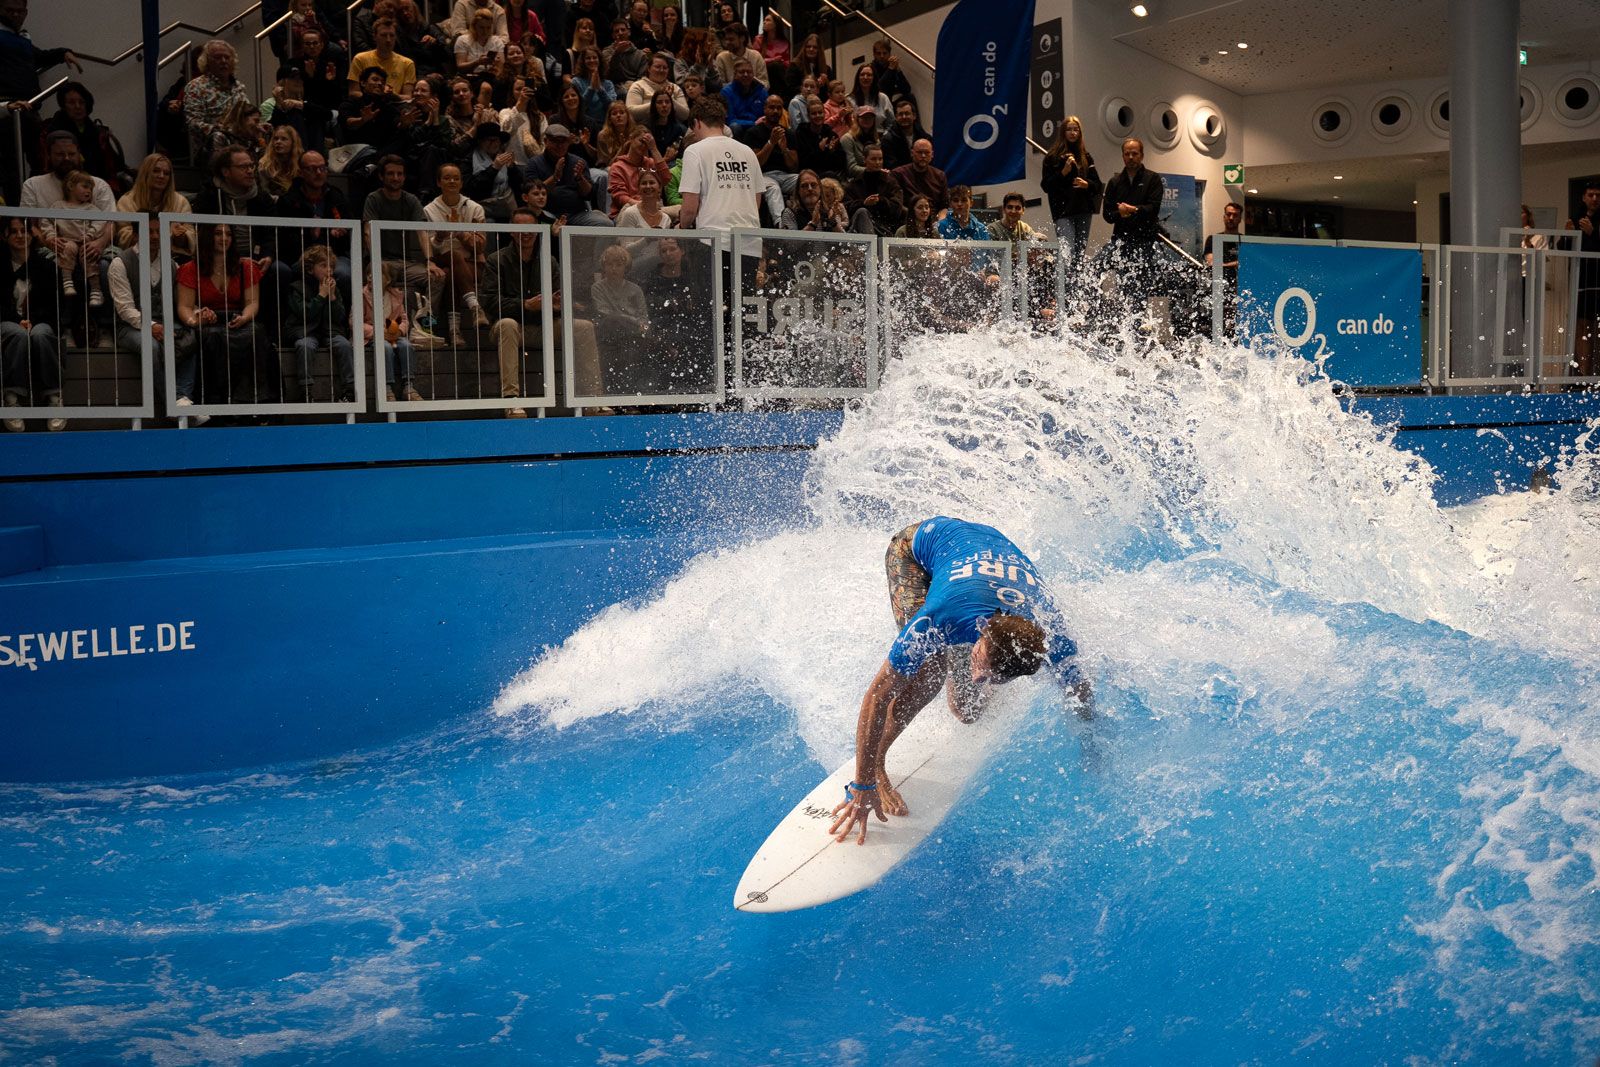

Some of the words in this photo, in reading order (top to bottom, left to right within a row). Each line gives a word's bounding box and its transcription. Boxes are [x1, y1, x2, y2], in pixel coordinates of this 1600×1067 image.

[982, 41, 997, 62] do
[984, 67, 995, 96] can
[716, 161, 748, 173] SURF
[717, 173, 751, 182] MASTERS
[1162, 188, 1179, 200] RF
[1336, 318, 1368, 335] can
[1372, 313, 1394, 335] do
